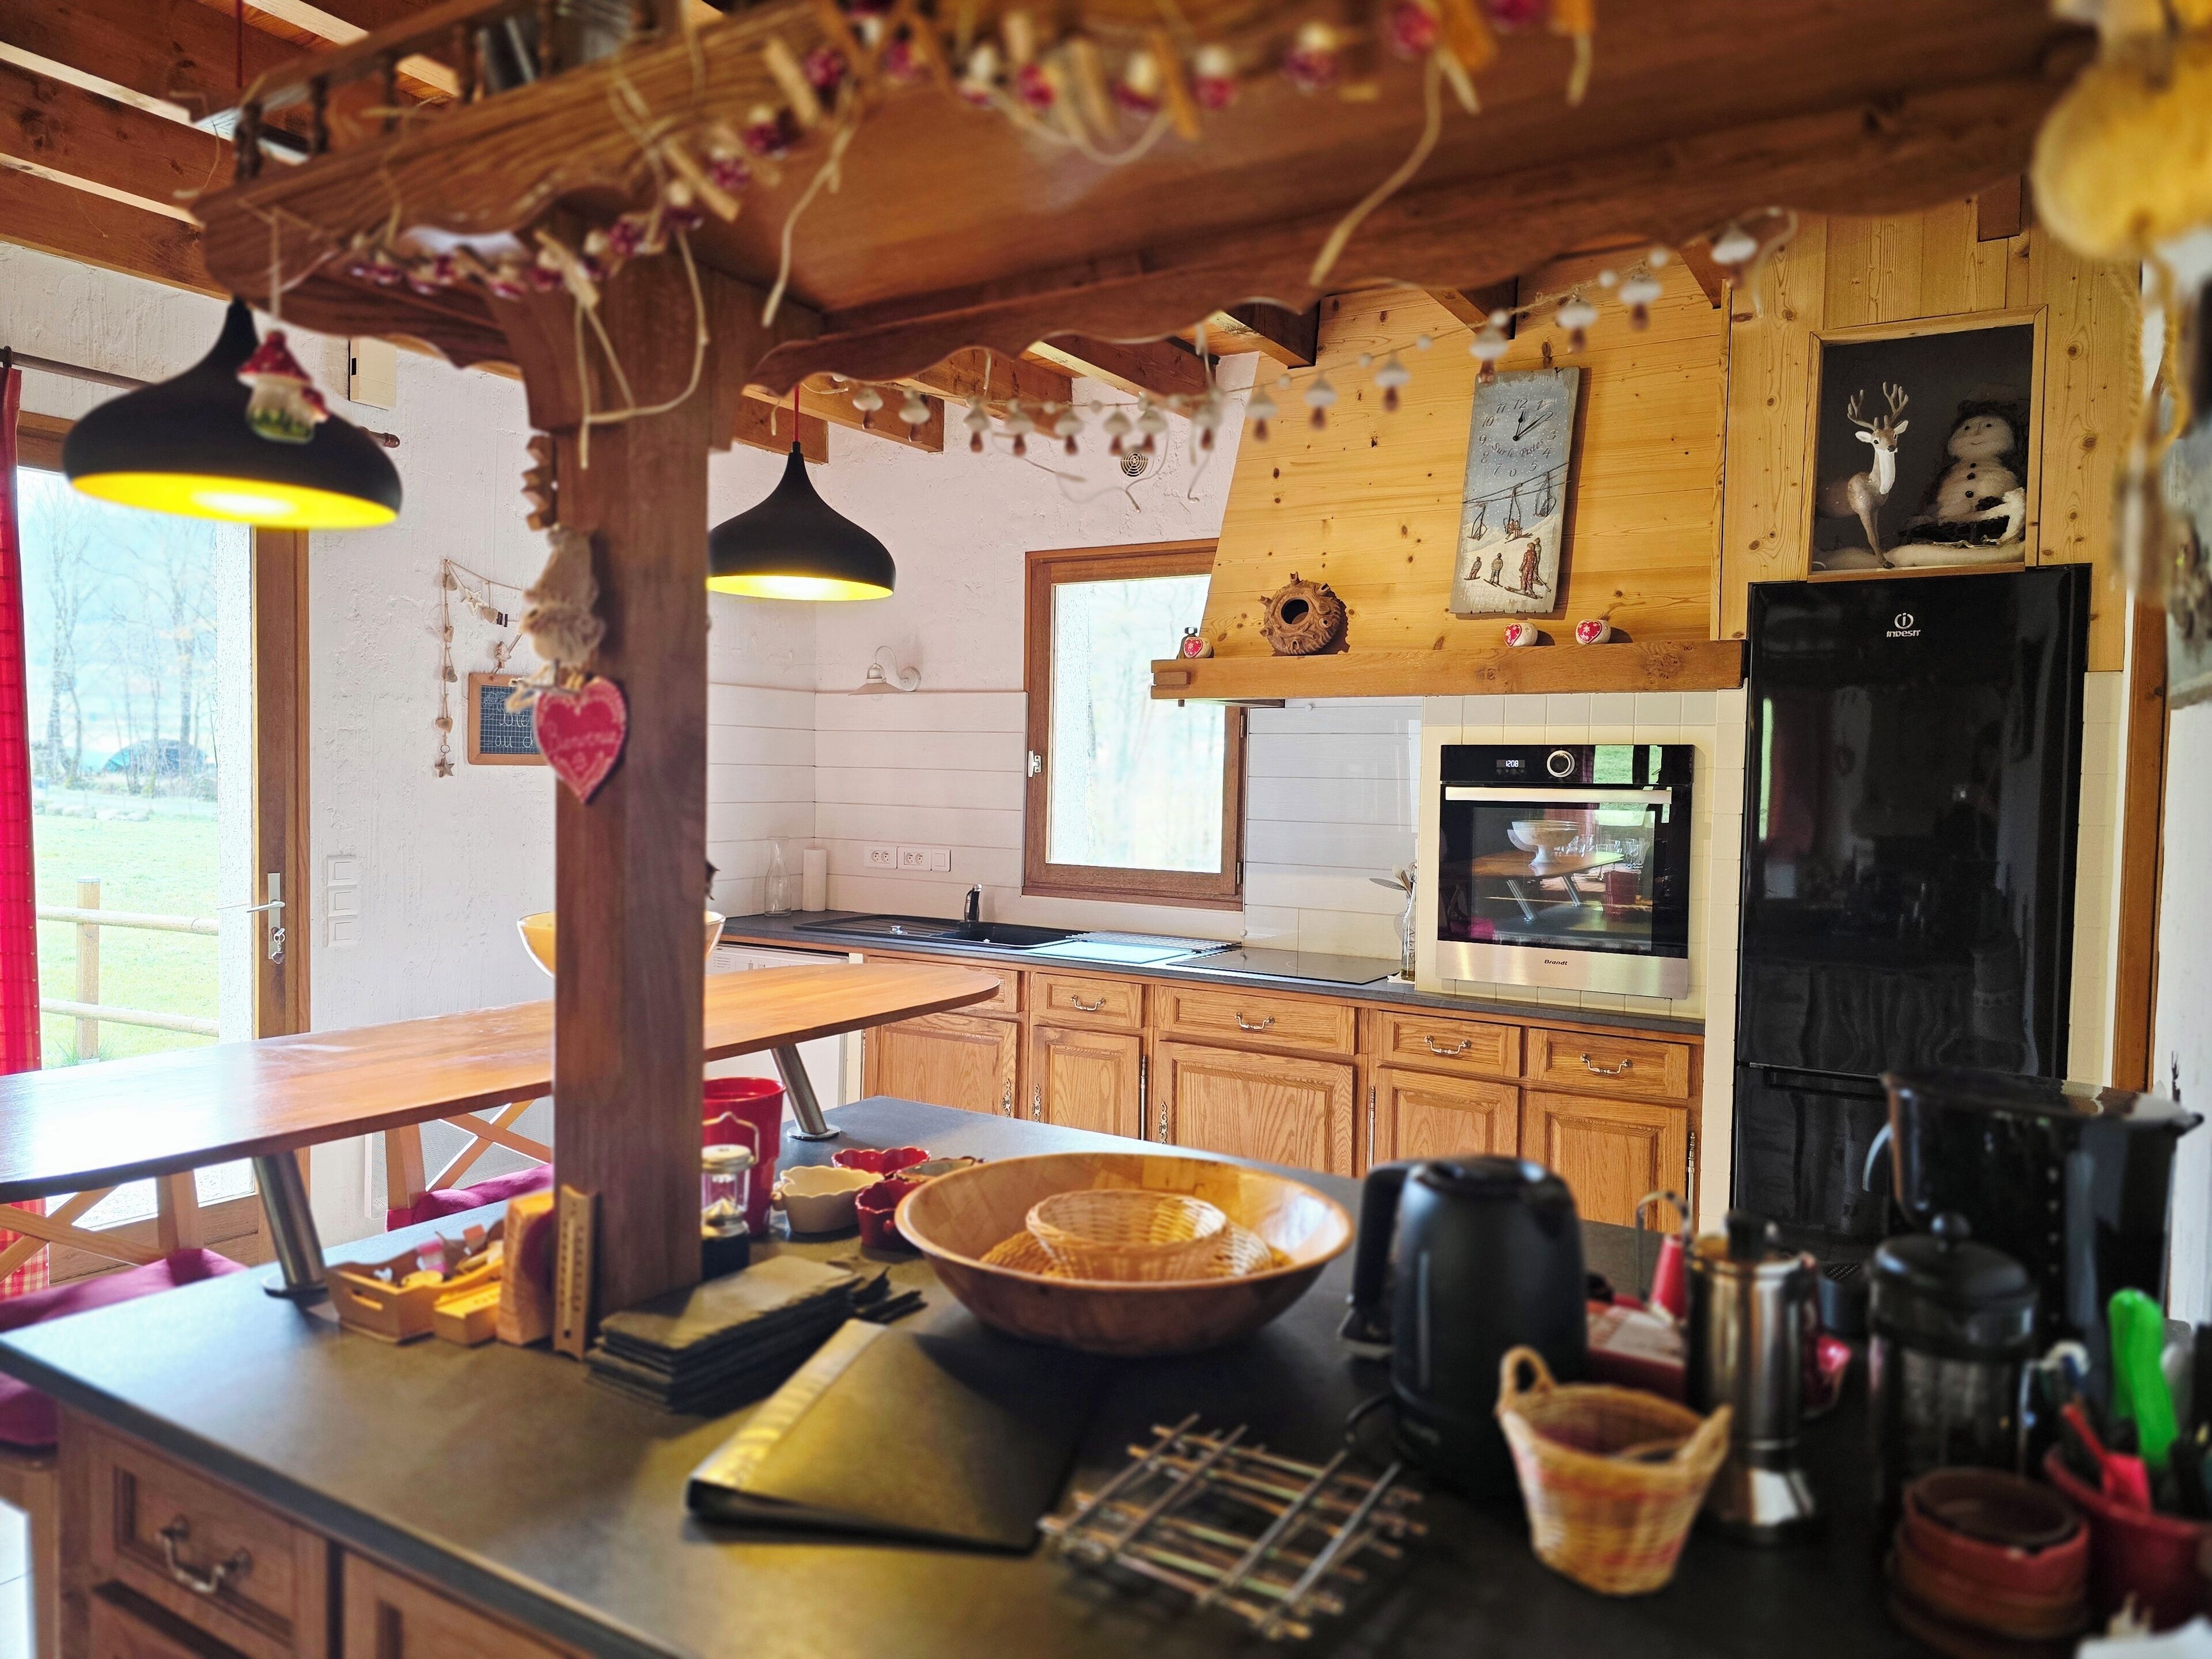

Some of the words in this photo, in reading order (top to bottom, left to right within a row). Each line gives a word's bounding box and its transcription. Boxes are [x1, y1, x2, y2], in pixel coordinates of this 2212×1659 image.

[1496, 403, 1507, 414] 11
[1513, 398, 1528, 409] 12
[1537, 400, 1543, 410] 1
[1482, 416, 1494, 428] 10
[1479, 434, 1487, 448] 9
[1547, 429, 1558, 441] 3
[1491, 442, 1507, 456] Sur
[1520, 438, 1544, 457] Pistes
[1542, 446, 1552, 459] 4
[1480, 451, 1490, 464] 8
[1493, 463, 1502, 475] 7
[1509, 465, 1517, 478] 6
[1529, 460, 1539, 472] 5
[495, 735, 513, 748] au
